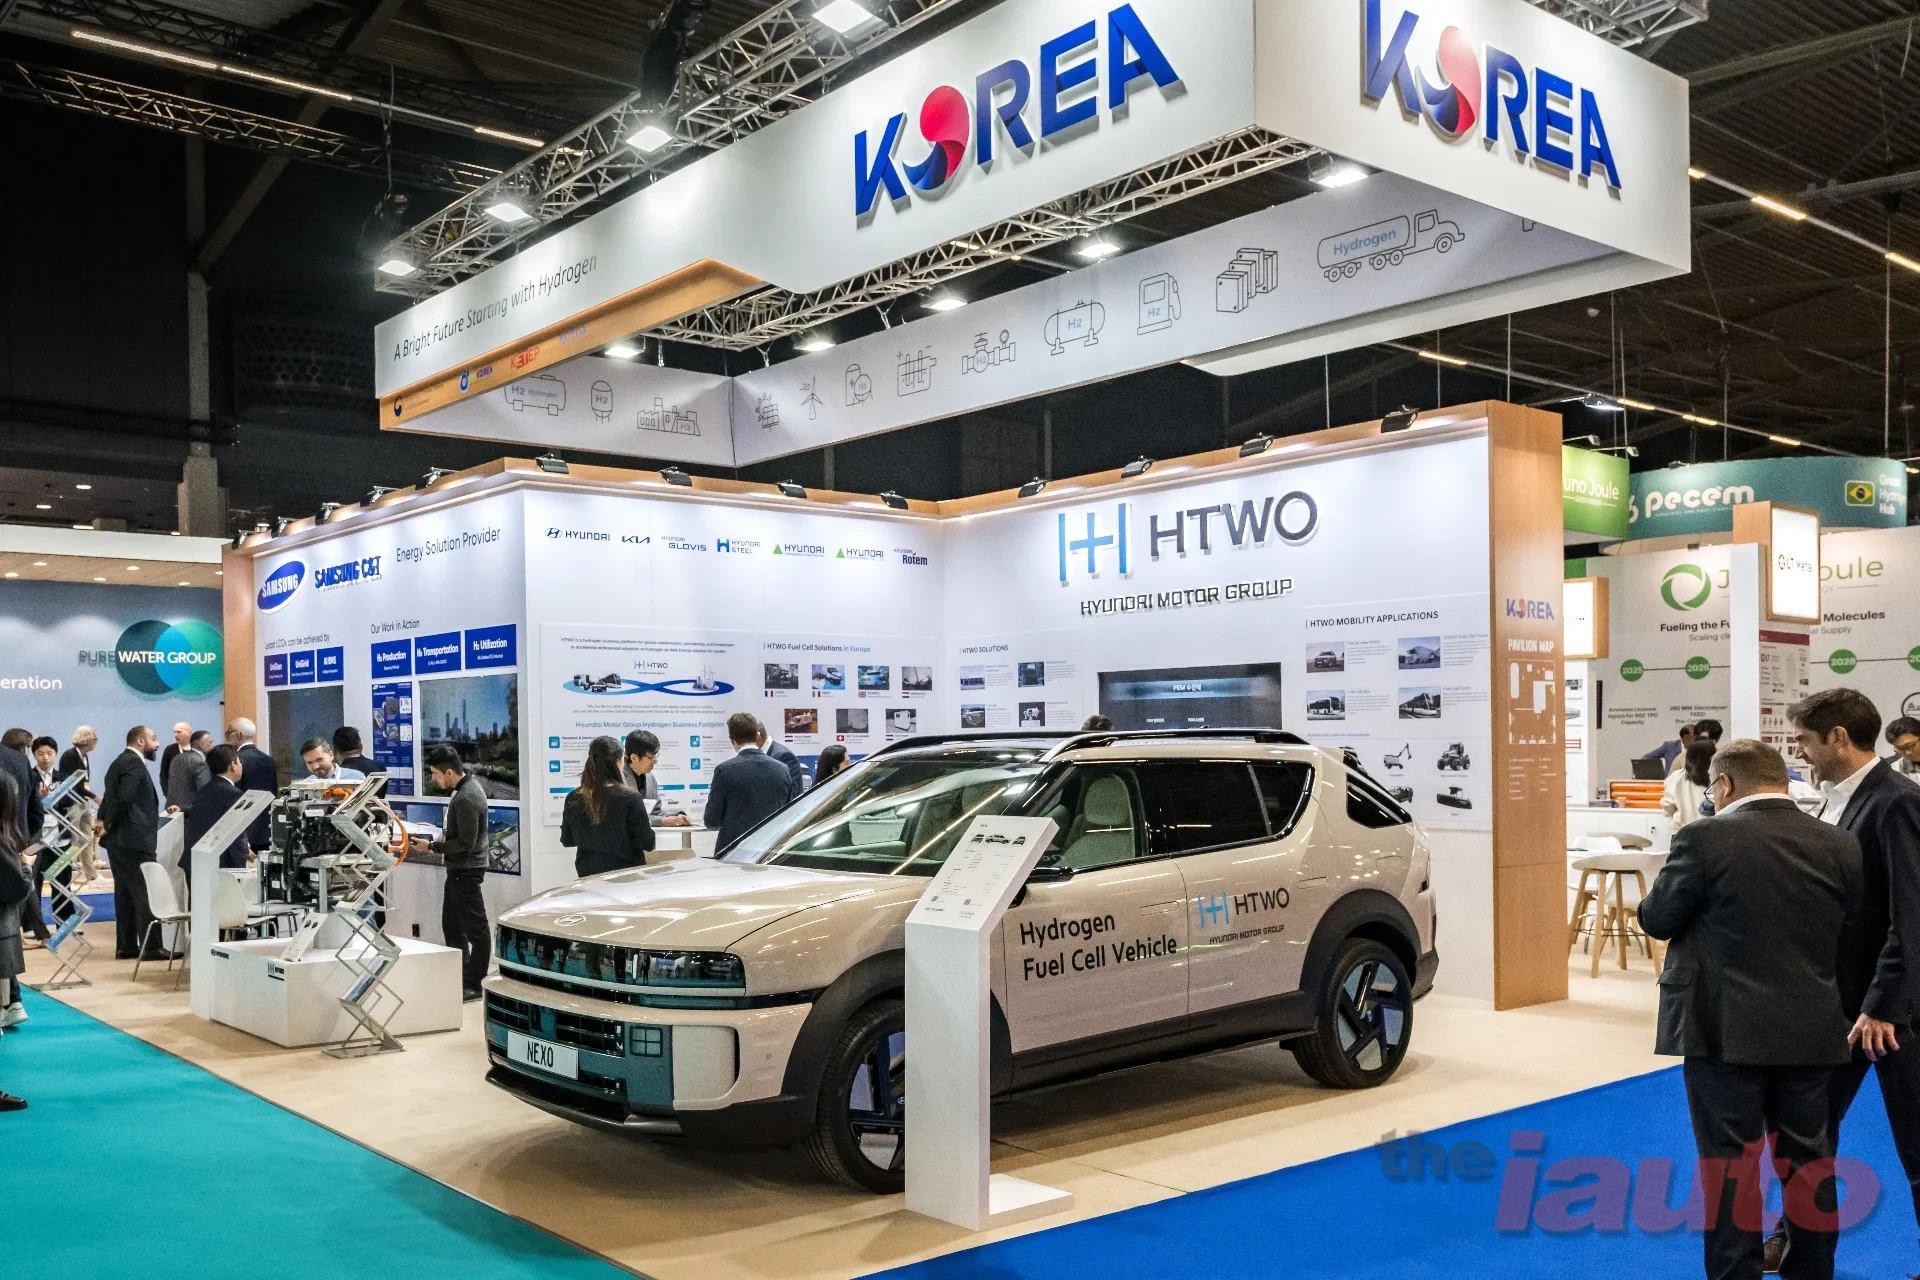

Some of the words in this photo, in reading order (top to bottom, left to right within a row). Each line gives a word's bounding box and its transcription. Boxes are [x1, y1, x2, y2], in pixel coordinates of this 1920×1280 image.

[1361, 0, 1621, 197] KOREA
[854, 3, 1185, 224] KOREA
[1333, 229, 1397, 255] Hydrogen
[394, 344, 400, 361] A
[403, 332, 431, 356] Bright
[432, 318, 464, 344] Future
[466, 299, 508, 329] Starting
[511, 282, 535, 308] with
[538, 255, 598, 298] Hydrogen
[1147, 306, 1161, 319] H2
[1067, 317, 1083, 331] H2
[476, 366, 493, 378] KOREA
[511, 384, 525, 395] H2
[595, 394, 608, 404] H2
[1588, 477, 1620, 500] Joule
[1879, 503, 1896, 515] Hub
[1150, 490, 1318, 557] HTWO
[565, 530, 611, 542] HYUNDAI
[621, 535, 651, 544] KIA
[396, 544, 424, 563] Energy
[425, 535, 461, 556] Solution
[462, 527, 501, 548] Provider
[668, 542, 707, 552] GLOVIS
[731, 539, 761, 548] HYUNDAI
[784, 543, 825, 554] HYUNDAI
[731, 547, 753, 555] STEEL
[846, 548, 884, 558] HYUNDAI
[902, 553, 928, 566] Rotem
[314, 560, 360, 589] SAMSUNG
[361, 556, 381, 578] C&T
[262, 573, 299, 598] SAMSUNG
[1081, 593, 1153, 616] HYUNDAI
[1157, 587, 1219, 609] MOTOR
[1225, 578, 1292, 600] GROUP
[1506, 598, 1555, 620] KOREA
[1310, 618, 1335, 628] HTWO
[1336, 615, 1375, 626] MOBILITY
[1376, 611, 1439, 623] APPLICATIONS
[1823, 610, 1886, 622] Molecules
[371, 624, 381, 634] Our
[381, 622, 395, 632] Work
[396, 621, 401, 631] in
[402, 619, 420, 630] Action
[1660, 622, 1698, 633] Fueling
[1700, 622, 1718, 630] the
[1820, 626, 1852, 635] Supply
[324, 633, 330, 644] by
[480, 638, 508, 649] Utilization
[1688, 633, 1719, 642] Scaling
[423, 644, 459, 657] Transportation
[814, 644, 843, 652] Solutions
[850, 645, 871, 653] Europe
[962, 646, 979, 654] HTWO
[979, 644, 1009, 653] SOLUTIONS
[1508, 638, 1538, 651] PAVILION
[1539, 641, 1555, 652] MAP
[78, 651, 116, 667] PURE
[118, 651, 165, 664] WATER
[167, 652, 216, 665] GROUP
[382, 651, 407, 662] Production
[1622, 666, 1643, 675] 2025
[0, 676, 63, 690] eration
[1234, 887, 1290, 916] HTWO
[1019, 914, 1116, 948] Hydrogen
[1209, 932, 1239, 945] HYUNDAI
[1239, 928, 1262, 940] MOTOR
[1263, 924, 1285, 937] GROUP
[1023, 952, 1065, 981] Fuel
[1071, 945, 1105, 972] Cell
[1111, 934, 1177, 964] Vehicle
[527, 1040, 554, 1068] NEXO
